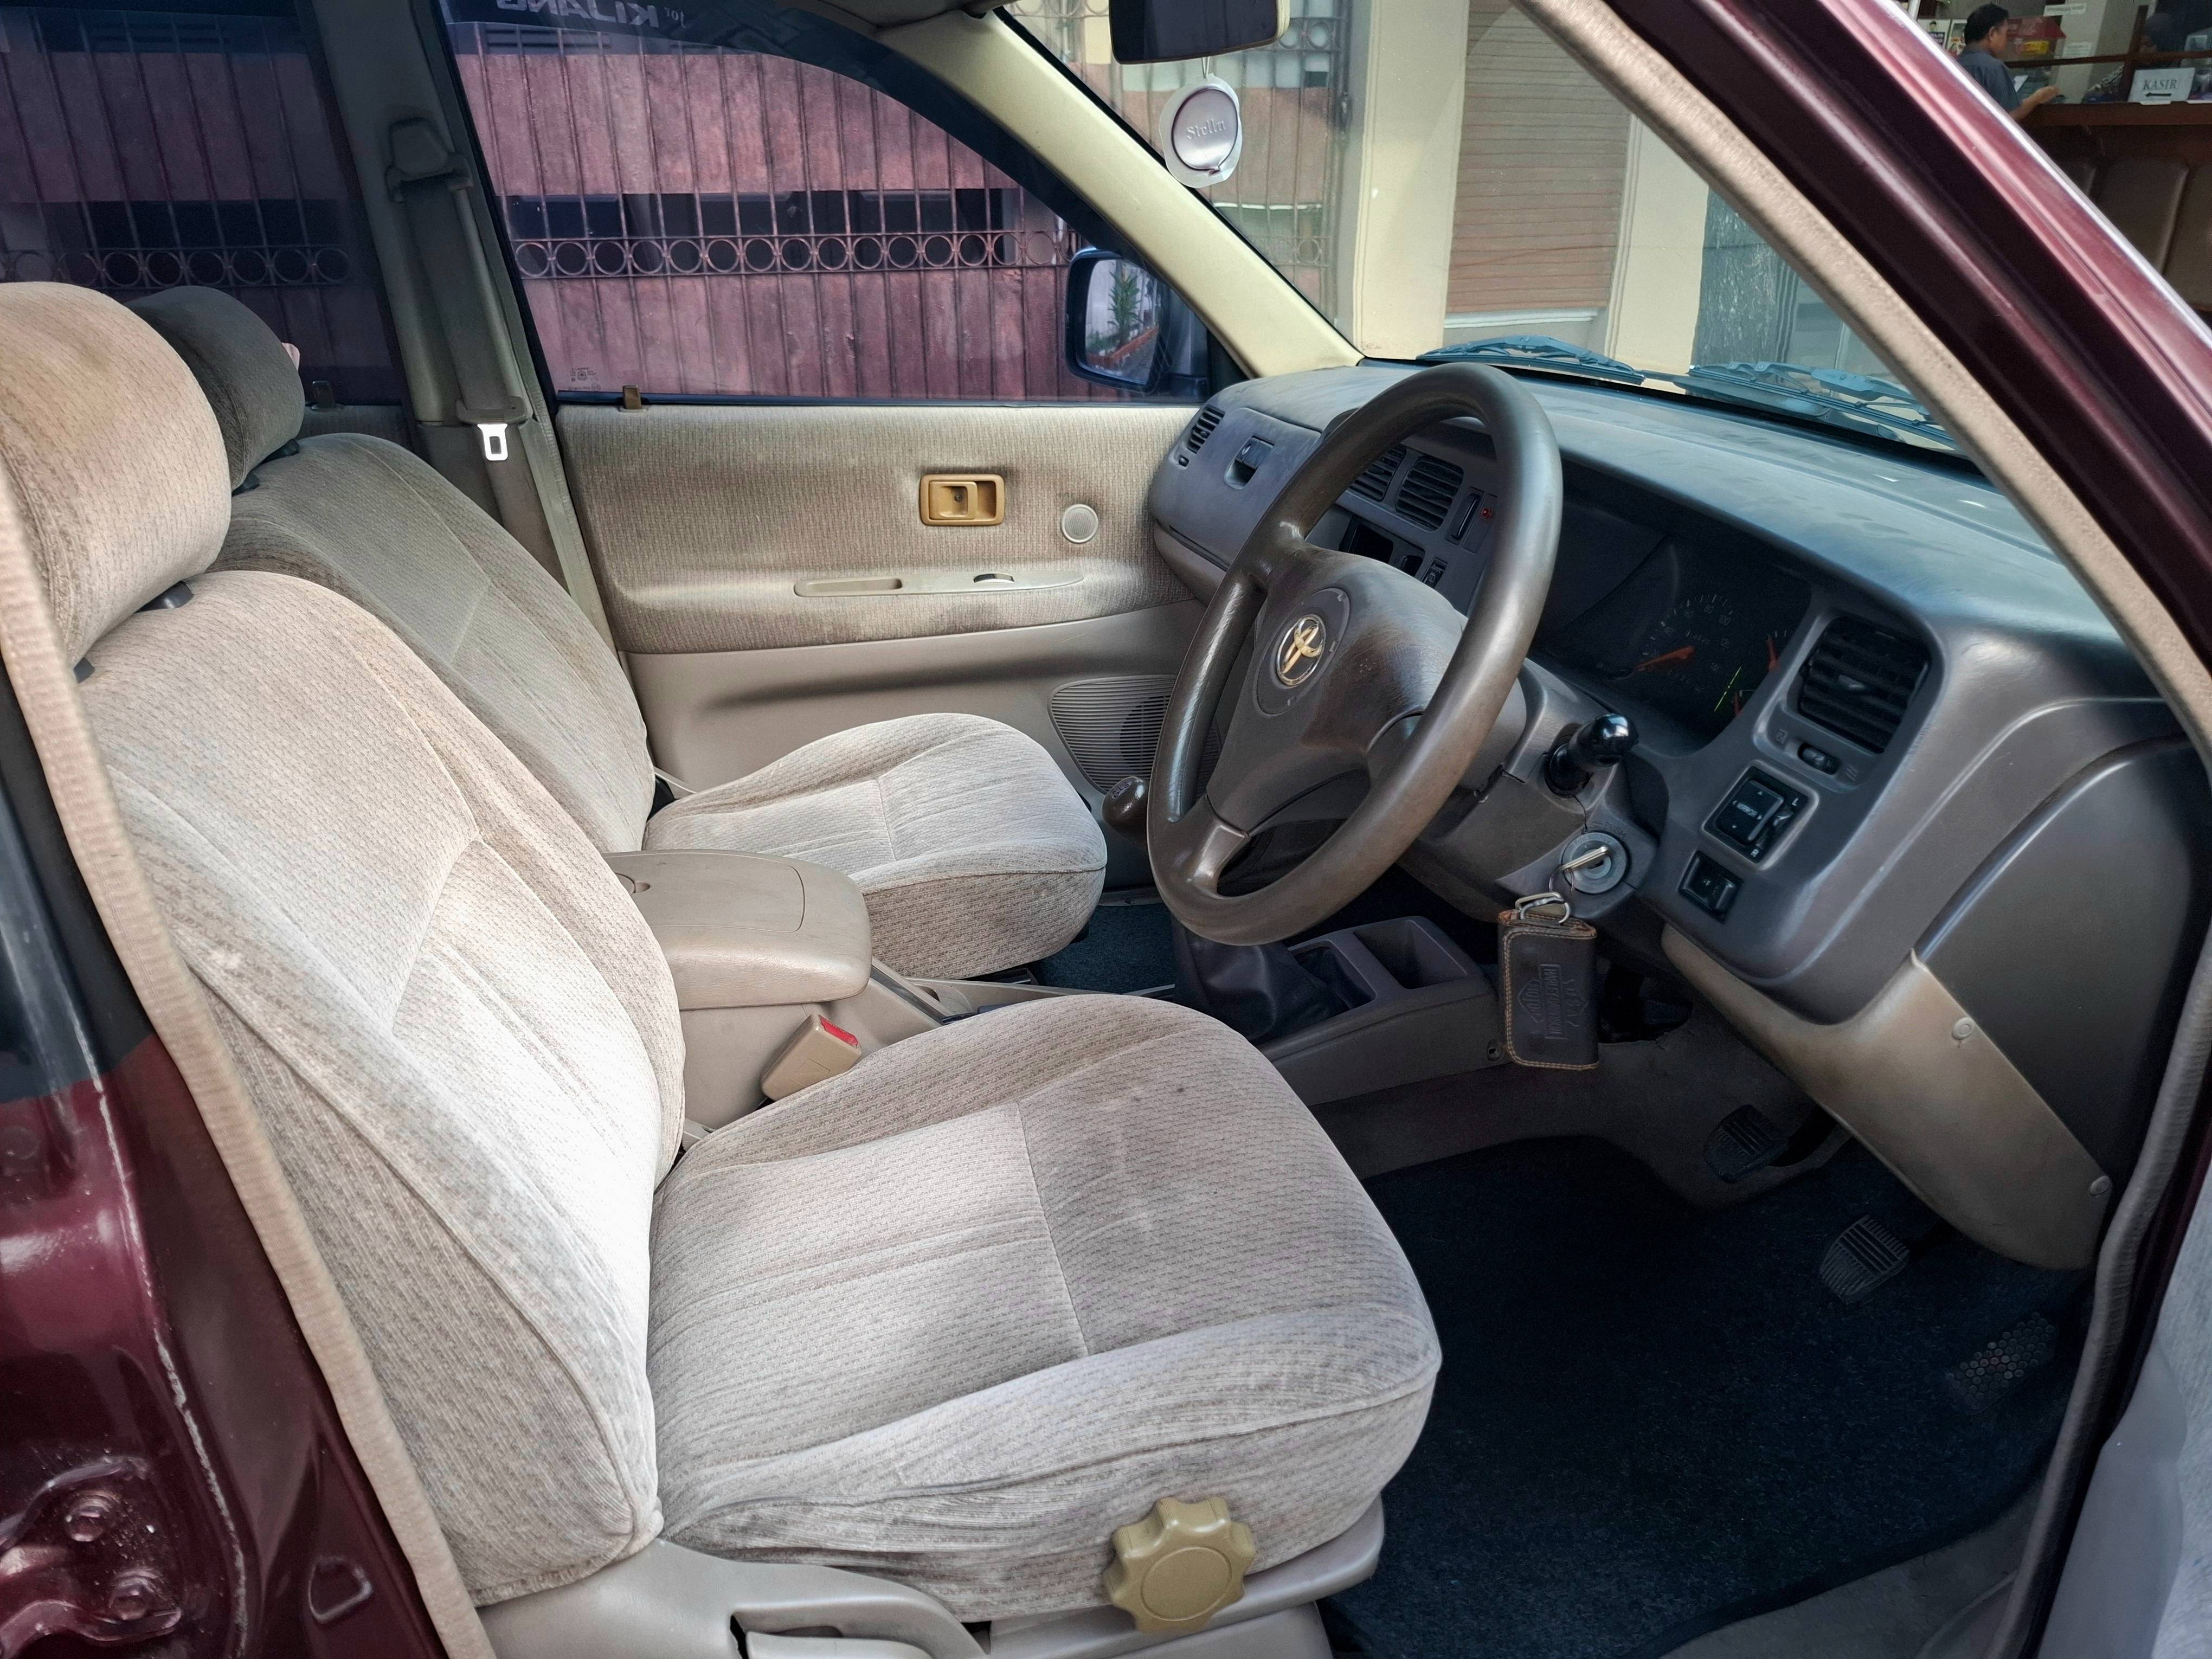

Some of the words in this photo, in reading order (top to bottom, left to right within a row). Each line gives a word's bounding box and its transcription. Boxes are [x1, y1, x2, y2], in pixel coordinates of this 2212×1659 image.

[2143, 79, 2178, 91] KASIR
[1187, 118, 1226, 140] Stella
[1791, 798, 1799, 807] L
[1751, 848, 1759, 858] R
